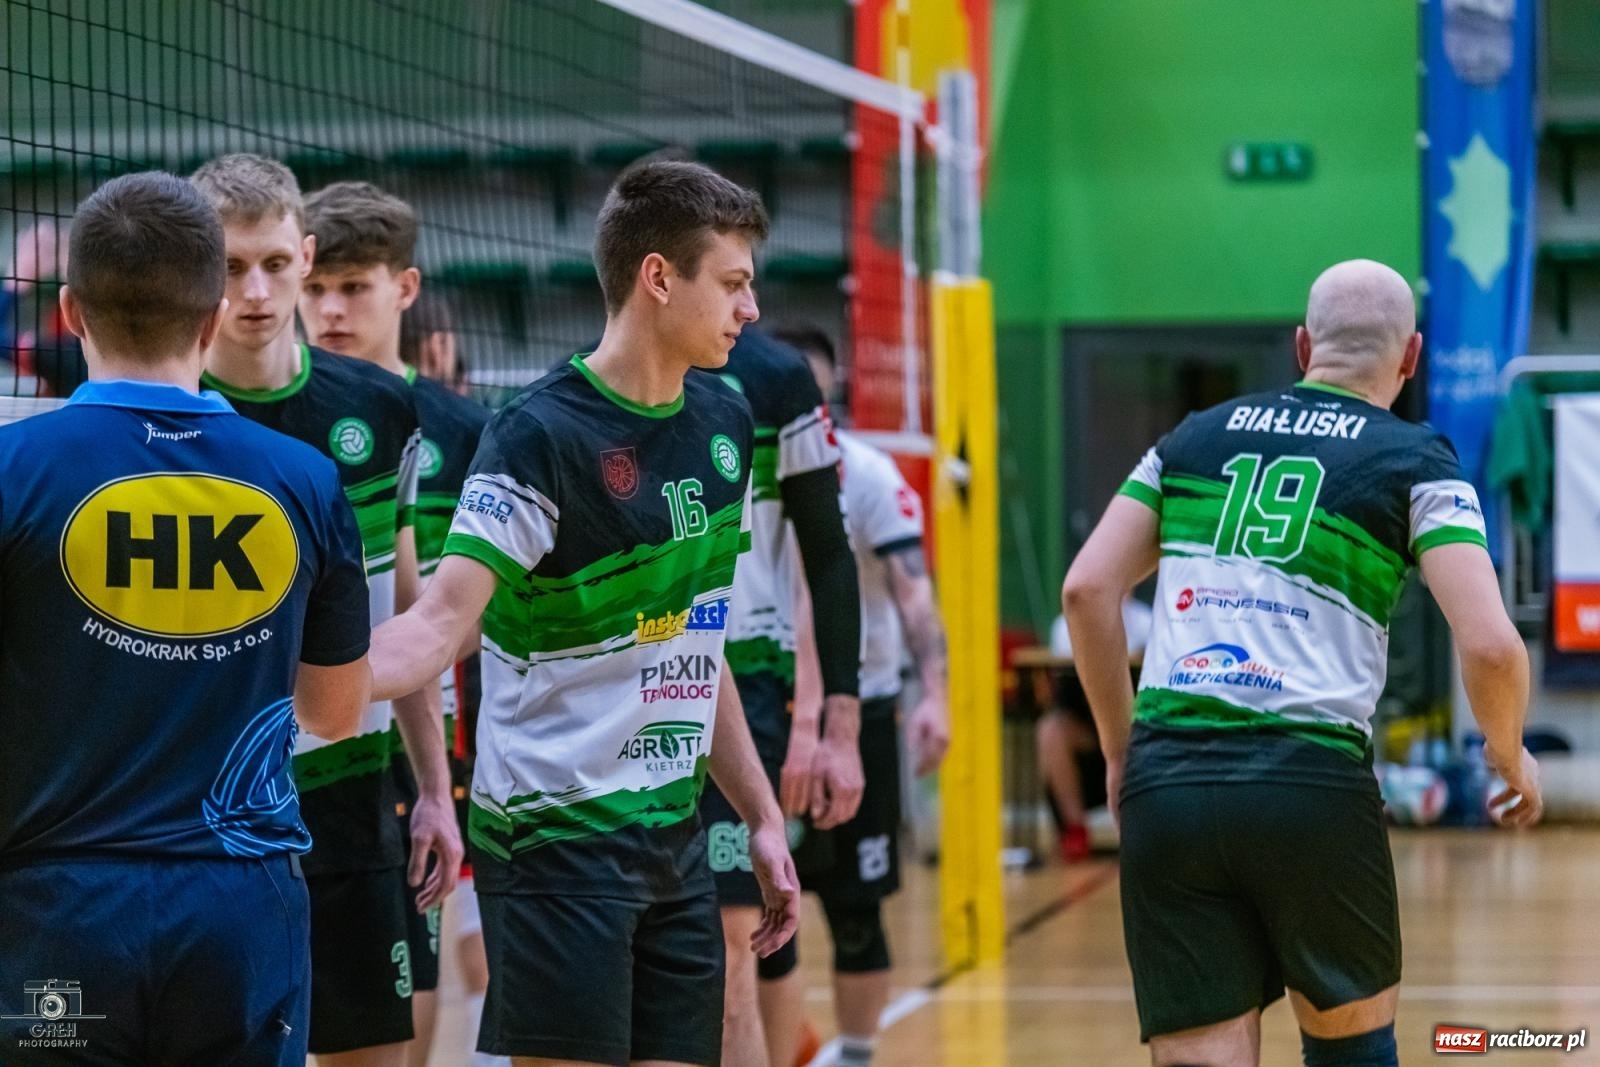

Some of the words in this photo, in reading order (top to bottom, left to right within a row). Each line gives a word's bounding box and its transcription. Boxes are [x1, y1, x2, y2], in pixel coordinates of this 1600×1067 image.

[1226, 406, 1367, 440] BIAŁUSKI
[662, 477, 708, 541] 16
[1213, 453, 1325, 564] 19
[106, 510, 265, 592] HK
[1196, 596, 1309, 620] VANESSA
[82, 617, 198, 661] HYDROKRAK
[202, 643, 231, 661] Sp.
[234, 639, 242, 652] z
[1168, 671, 1282, 692] UBEZPIECZENIA
